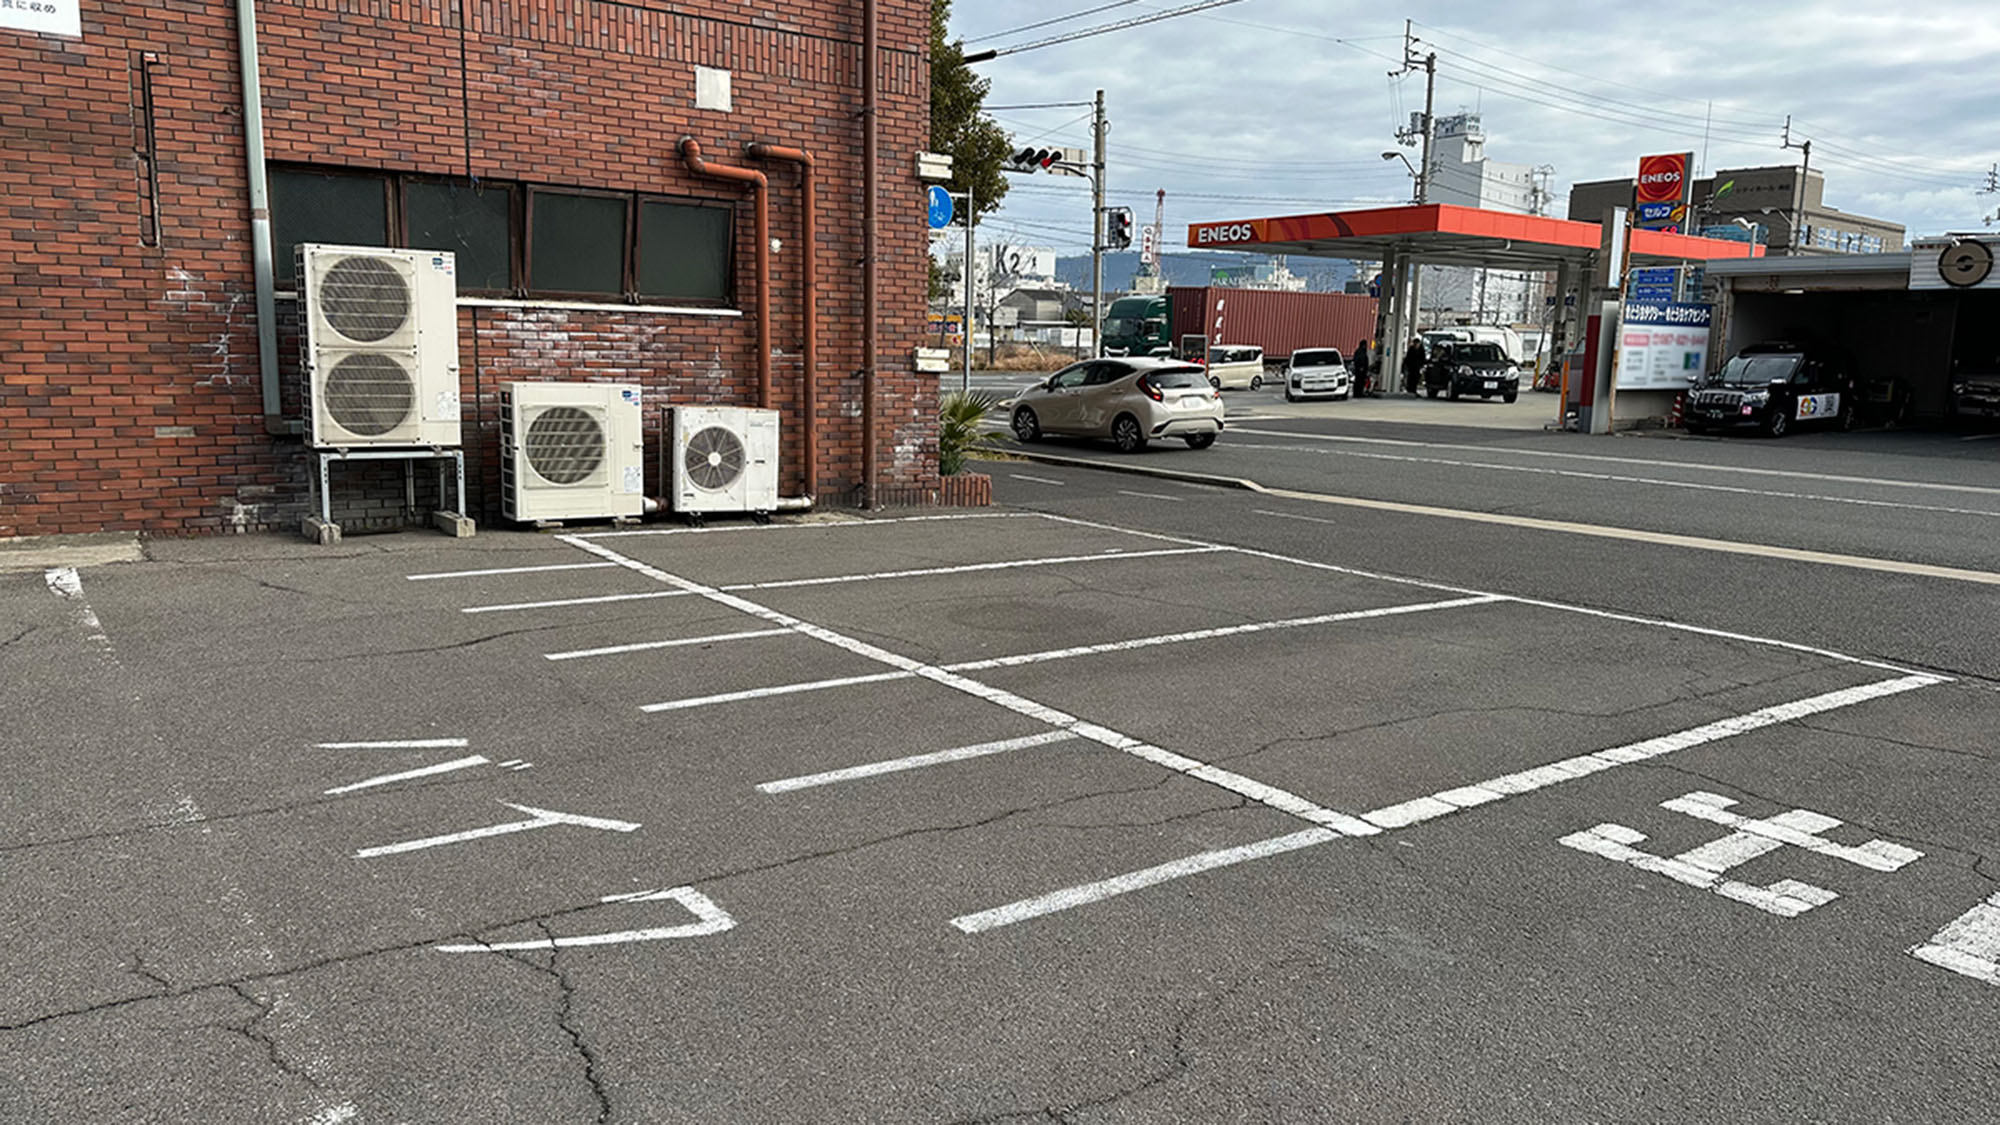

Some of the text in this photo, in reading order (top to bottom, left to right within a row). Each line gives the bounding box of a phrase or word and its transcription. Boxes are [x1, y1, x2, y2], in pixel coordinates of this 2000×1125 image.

[1641, 171, 1681, 184] ENEOS
[1644, 206, 1671, 219] セルフ
[1198, 223, 1252, 243] ENEOS
[1557, 791, 1925, 917] 出
